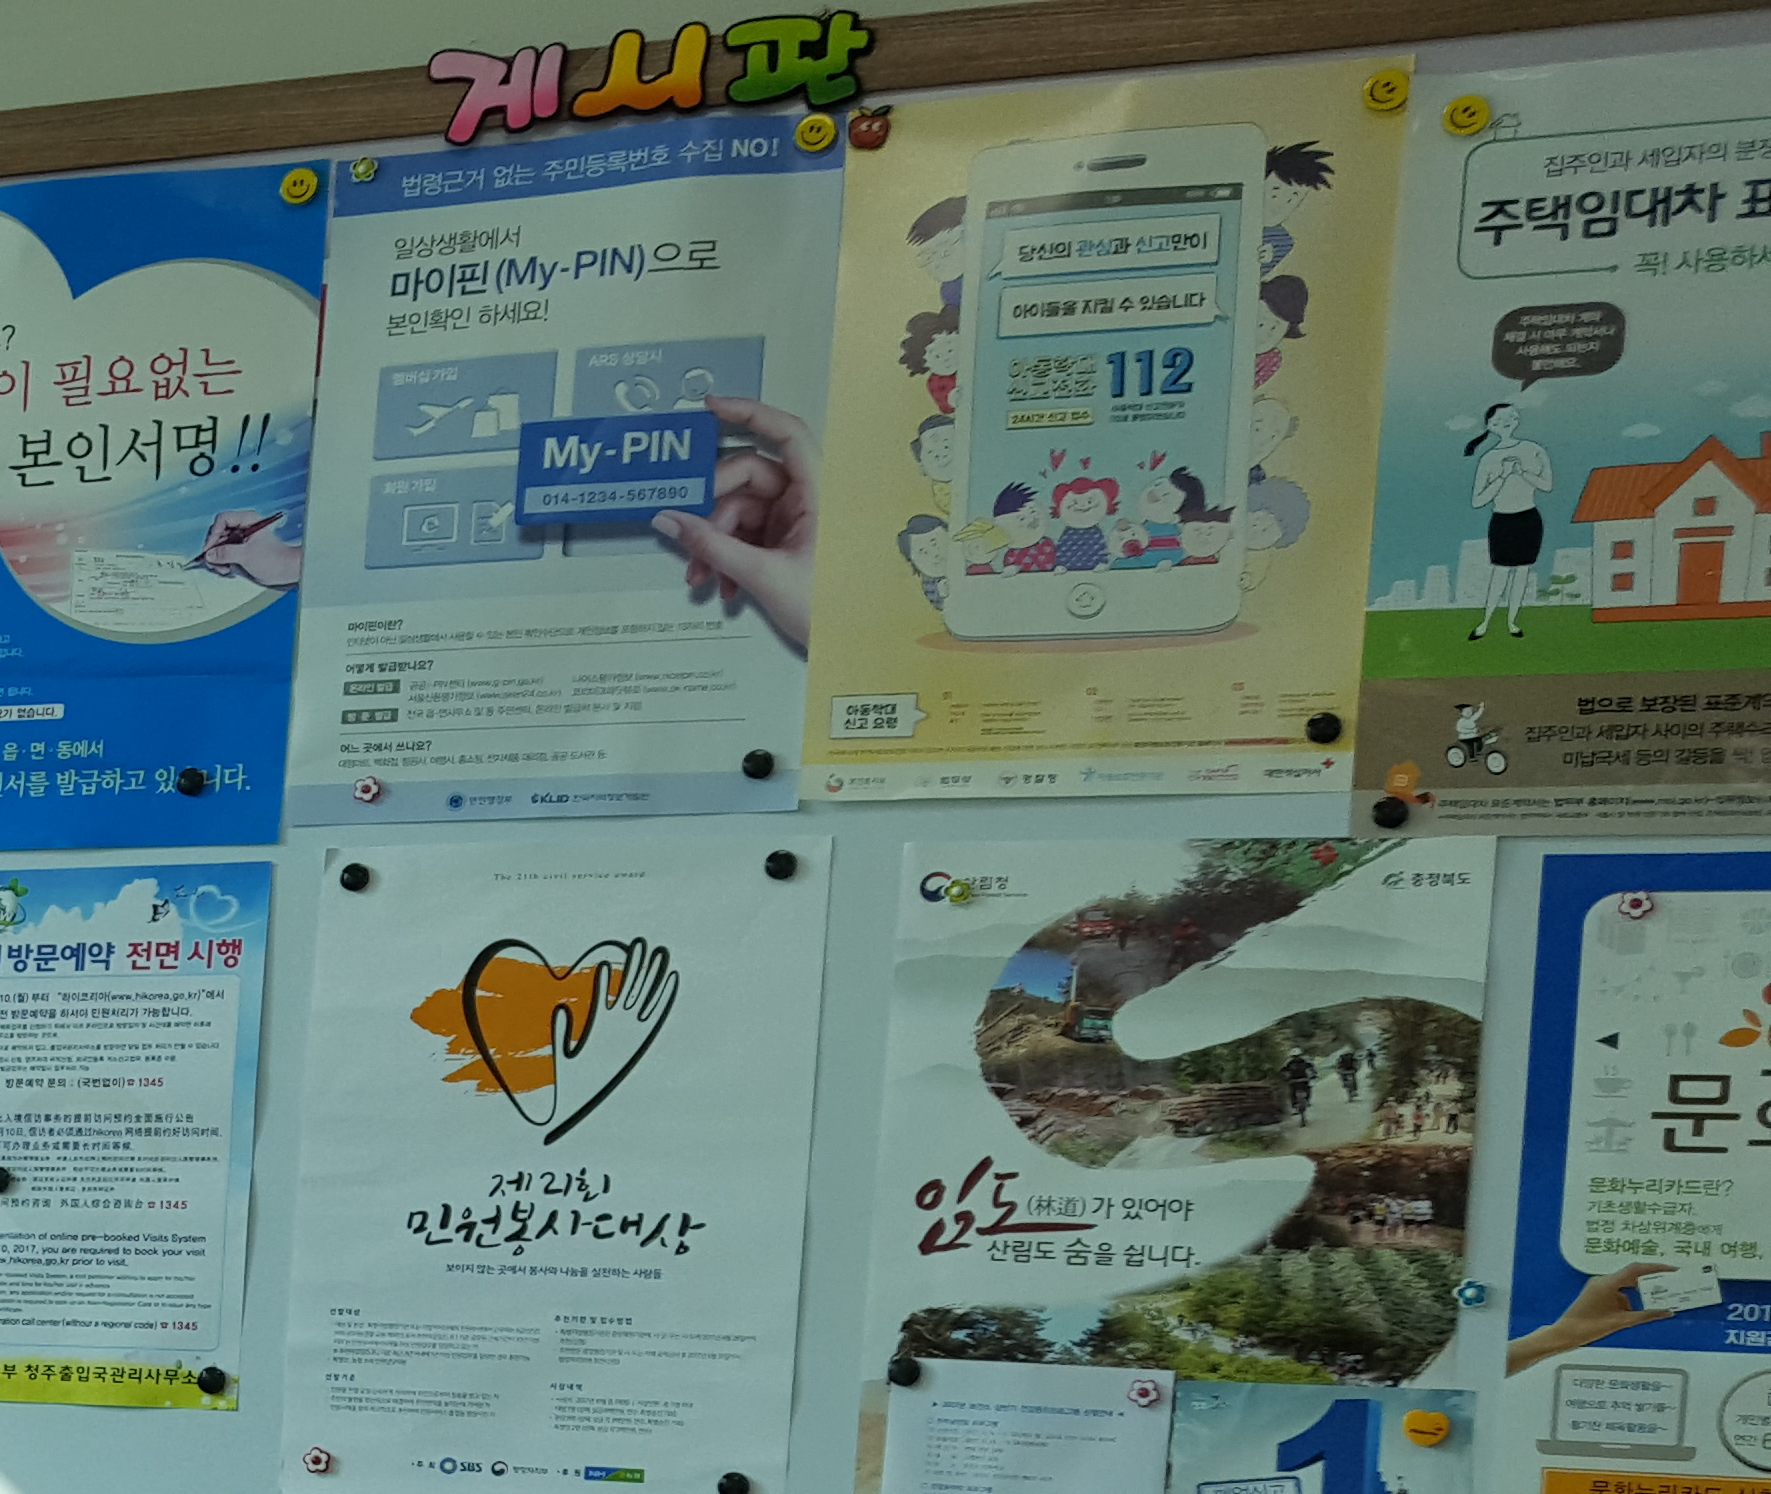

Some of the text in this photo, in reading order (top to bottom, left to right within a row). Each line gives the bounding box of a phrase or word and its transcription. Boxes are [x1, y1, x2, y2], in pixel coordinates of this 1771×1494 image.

[428, 11, 875, 145] 게시판
[402, 137, 778, 196] 법령근거 없는 주민등록번호 수집 NO!
[1544, 142, 1726, 178] 집주인과 세입자의
[1474, 182, 1726, 246] 주택임대차
[393, 225, 522, 261] 일상생활에서
[1018, 230, 1207, 263] 당신의 관심과 신고만이
[1012, 292, 1206, 319] 아이들을 지킬 수 있습니다
[386, 299, 549, 337] 본인확인 하세요!
[54, 347, 242, 409] 필요없는
[1106, 347, 1194, 398] 112
[9, 413, 271, 487] 본인서명!!
[542, 428, 693, 474] My-PIN
[543, 486, 689, 505] 014-1234-567890
[348, 619, 403, 631] 마이핀이란?
[17, 707, 57, 719] 없습니다.
[1577, 695, 1697, 716] 법으로 보장된
[1525, 721, 1703, 742] 집주인과 세입자 사이의
[1563, 750, 1631, 767] 미납국세
[1635, 749, 1670, 765] 등의
[57, 768, 146, 796] 발급하고
[1411, 870, 1471, 888] 충청북도
[7, 942, 116, 973] 방문예약
[125, 939, 180, 971] 전면
[186, 937, 243, 970] 시행
[32, 992, 49, 1003] 부터
[11, 1009, 56, 1019] 방문예약을
[60, 1009, 88, 1019] 하셔야
[91, 1007, 138, 1019] 민원처리가
[142, 1006, 192, 1018] 가능합니다.
[48, 1077, 164, 1088] 문의 1345
[1588, 1176, 1734, 1196] 문화누리카드란?
[160, 1201, 187, 1210] 1345
[915, 1156, 1194, 1256] 임도 있어야
[39, 1232, 47, 1241] of
[50, 1232, 78, 1242] online
[81, 1234, 139, 1244] pre-booked
[143, 1234, 168, 1243] Visits
[172, 1234, 206, 1244] System
[407, 1201, 707, 1256] 민원봉사대상
[42, 1246, 58, 1256] you
[80, 1246, 119, 1257] required
[123, 1247, 131, 1255] to
[135, 1246, 158, 1256] book
[162, 1248, 183, 1258] your
[186, 1248, 205, 1256] visit
[986, 1236, 1201, 1270] 산림도 숨을 쉽니다.
[1675, 1240, 1710, 1257] 국내
[72, 1257, 92, 1267] prior
[96, 1257, 105, 1265] to
[108, 1257, 128, 1267] visit.
[446, 1263, 662, 1279] 보이지 않는 곳에서 봉사와 나눔을 실천하는 사람들
[22, 1317, 198, 1330] call center 1345
[24, 1363, 199, 1385] 청주출입국관리사무소
